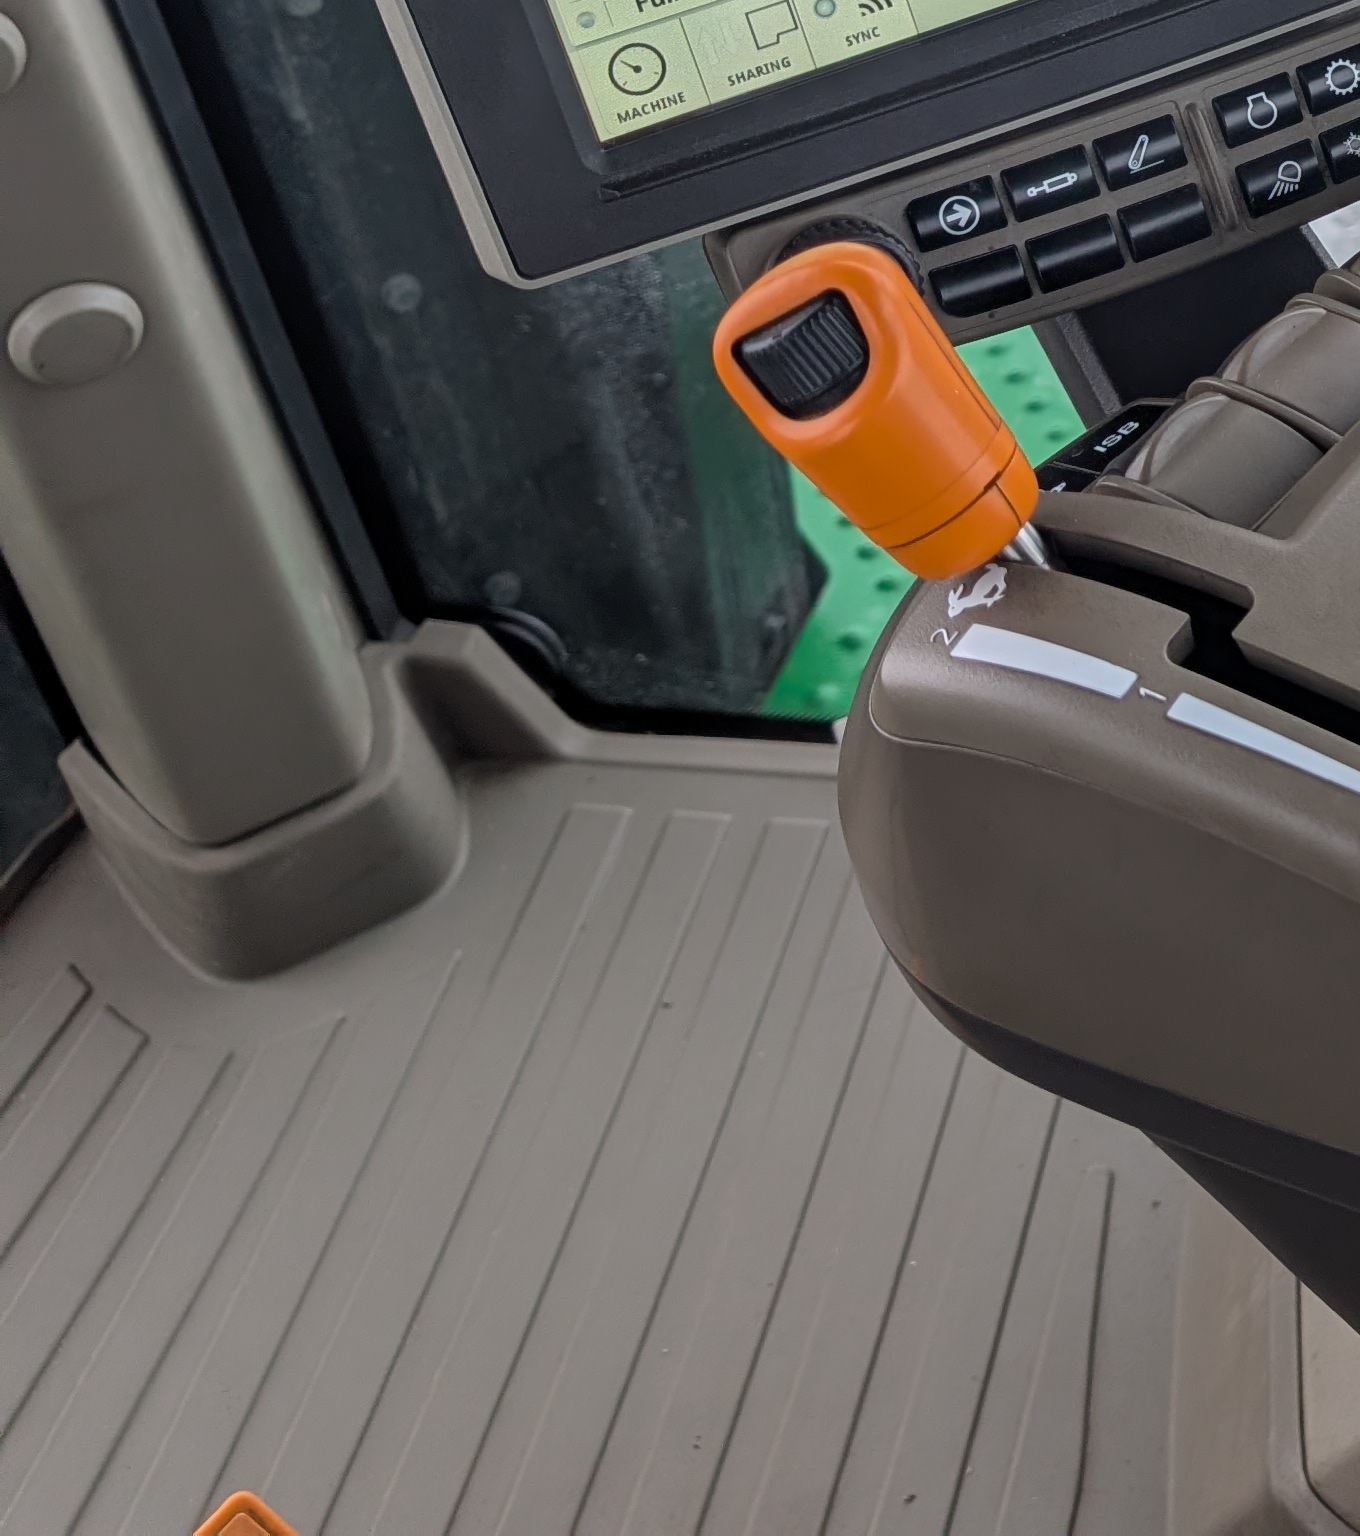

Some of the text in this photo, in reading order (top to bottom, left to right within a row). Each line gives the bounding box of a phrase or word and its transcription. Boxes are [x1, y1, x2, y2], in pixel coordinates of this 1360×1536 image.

[845, 26, 881, 47] SYNC
[727, 56, 792, 87] SHARING
[617, 92, 686, 124] MACHINE
[929, 626, 958, 647] 2
[1139, 687, 1168, 702] 1
